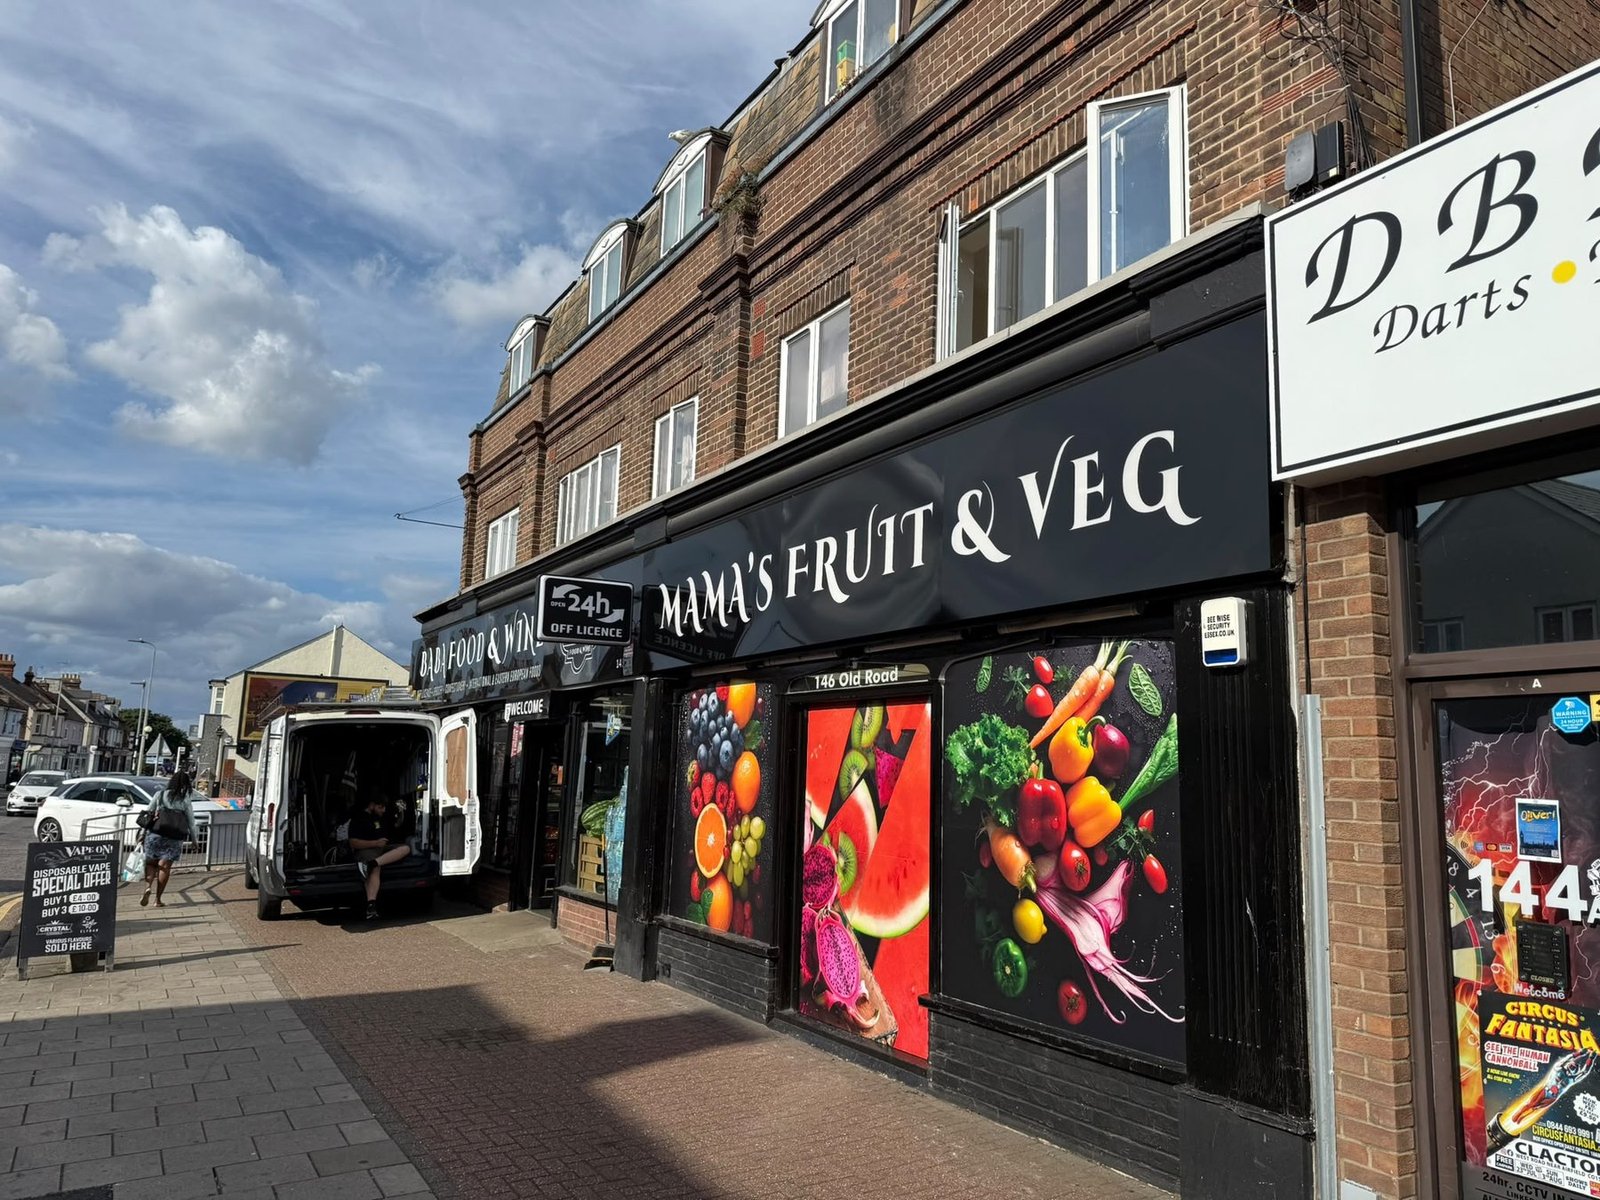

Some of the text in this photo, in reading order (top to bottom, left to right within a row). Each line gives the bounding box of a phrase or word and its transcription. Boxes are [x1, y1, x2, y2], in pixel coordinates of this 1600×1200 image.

[1373, 274, 1532, 354] Darts
[658, 429, 1202, 637] MAMA'S FRUIT & VEG
[567, 591, 610, 618] 24h
[550, 623, 623, 638] OFF LICENCE
[1206, 621, 1231, 631] SECURITY
[419, 608, 544, 682] BABA FOOD & WIN
[814, 665, 899, 690] 146 Old Road
[1531, 678, 1542, 688] A
[510, 698, 544, 716] WELCOME
[64, 843, 114, 858] VAPE ON!
[33, 861, 111, 879] DISPOSABLE VAPE
[31, 870, 111, 898] SPECIAL OFFER
[43, 895, 61, 907] BUY
[63, 894, 68, 904] 1
[41, 906, 60, 918] BUY
[60, 905, 68, 915] 3
[39, 925, 70, 933] CRYSTAL
[44, 941, 93, 953] SOLD HERE
[45, 936, 93, 945] VARIOUS FLAVOURS
[1530, 973, 1555, 984] CLOSED
[1514, 983, 1566, 1000] Welcome
[1505, 1001, 1579, 1027] CIRCUS
[1484, 1013, 1600, 1057] FANTASIA
[1484, 1041, 1550, 1063] SEE THE HUMAN
[1485, 1052, 1538, 1072] CANNONBALL
[1515, 1153, 1530, 1161] WEST
[1530, 1157, 1546, 1165] ROAD
[1546, 1161, 1561, 1170] NEAR
[1562, 1165, 1586, 1177] AIRFIELD
[1520, 1161, 1534, 1170] WED
[1546, 1169, 1559, 1177] SUN
[1549, 1176, 1563, 1185] AUG
[1516, 1182, 1549, 1199] CCTV
